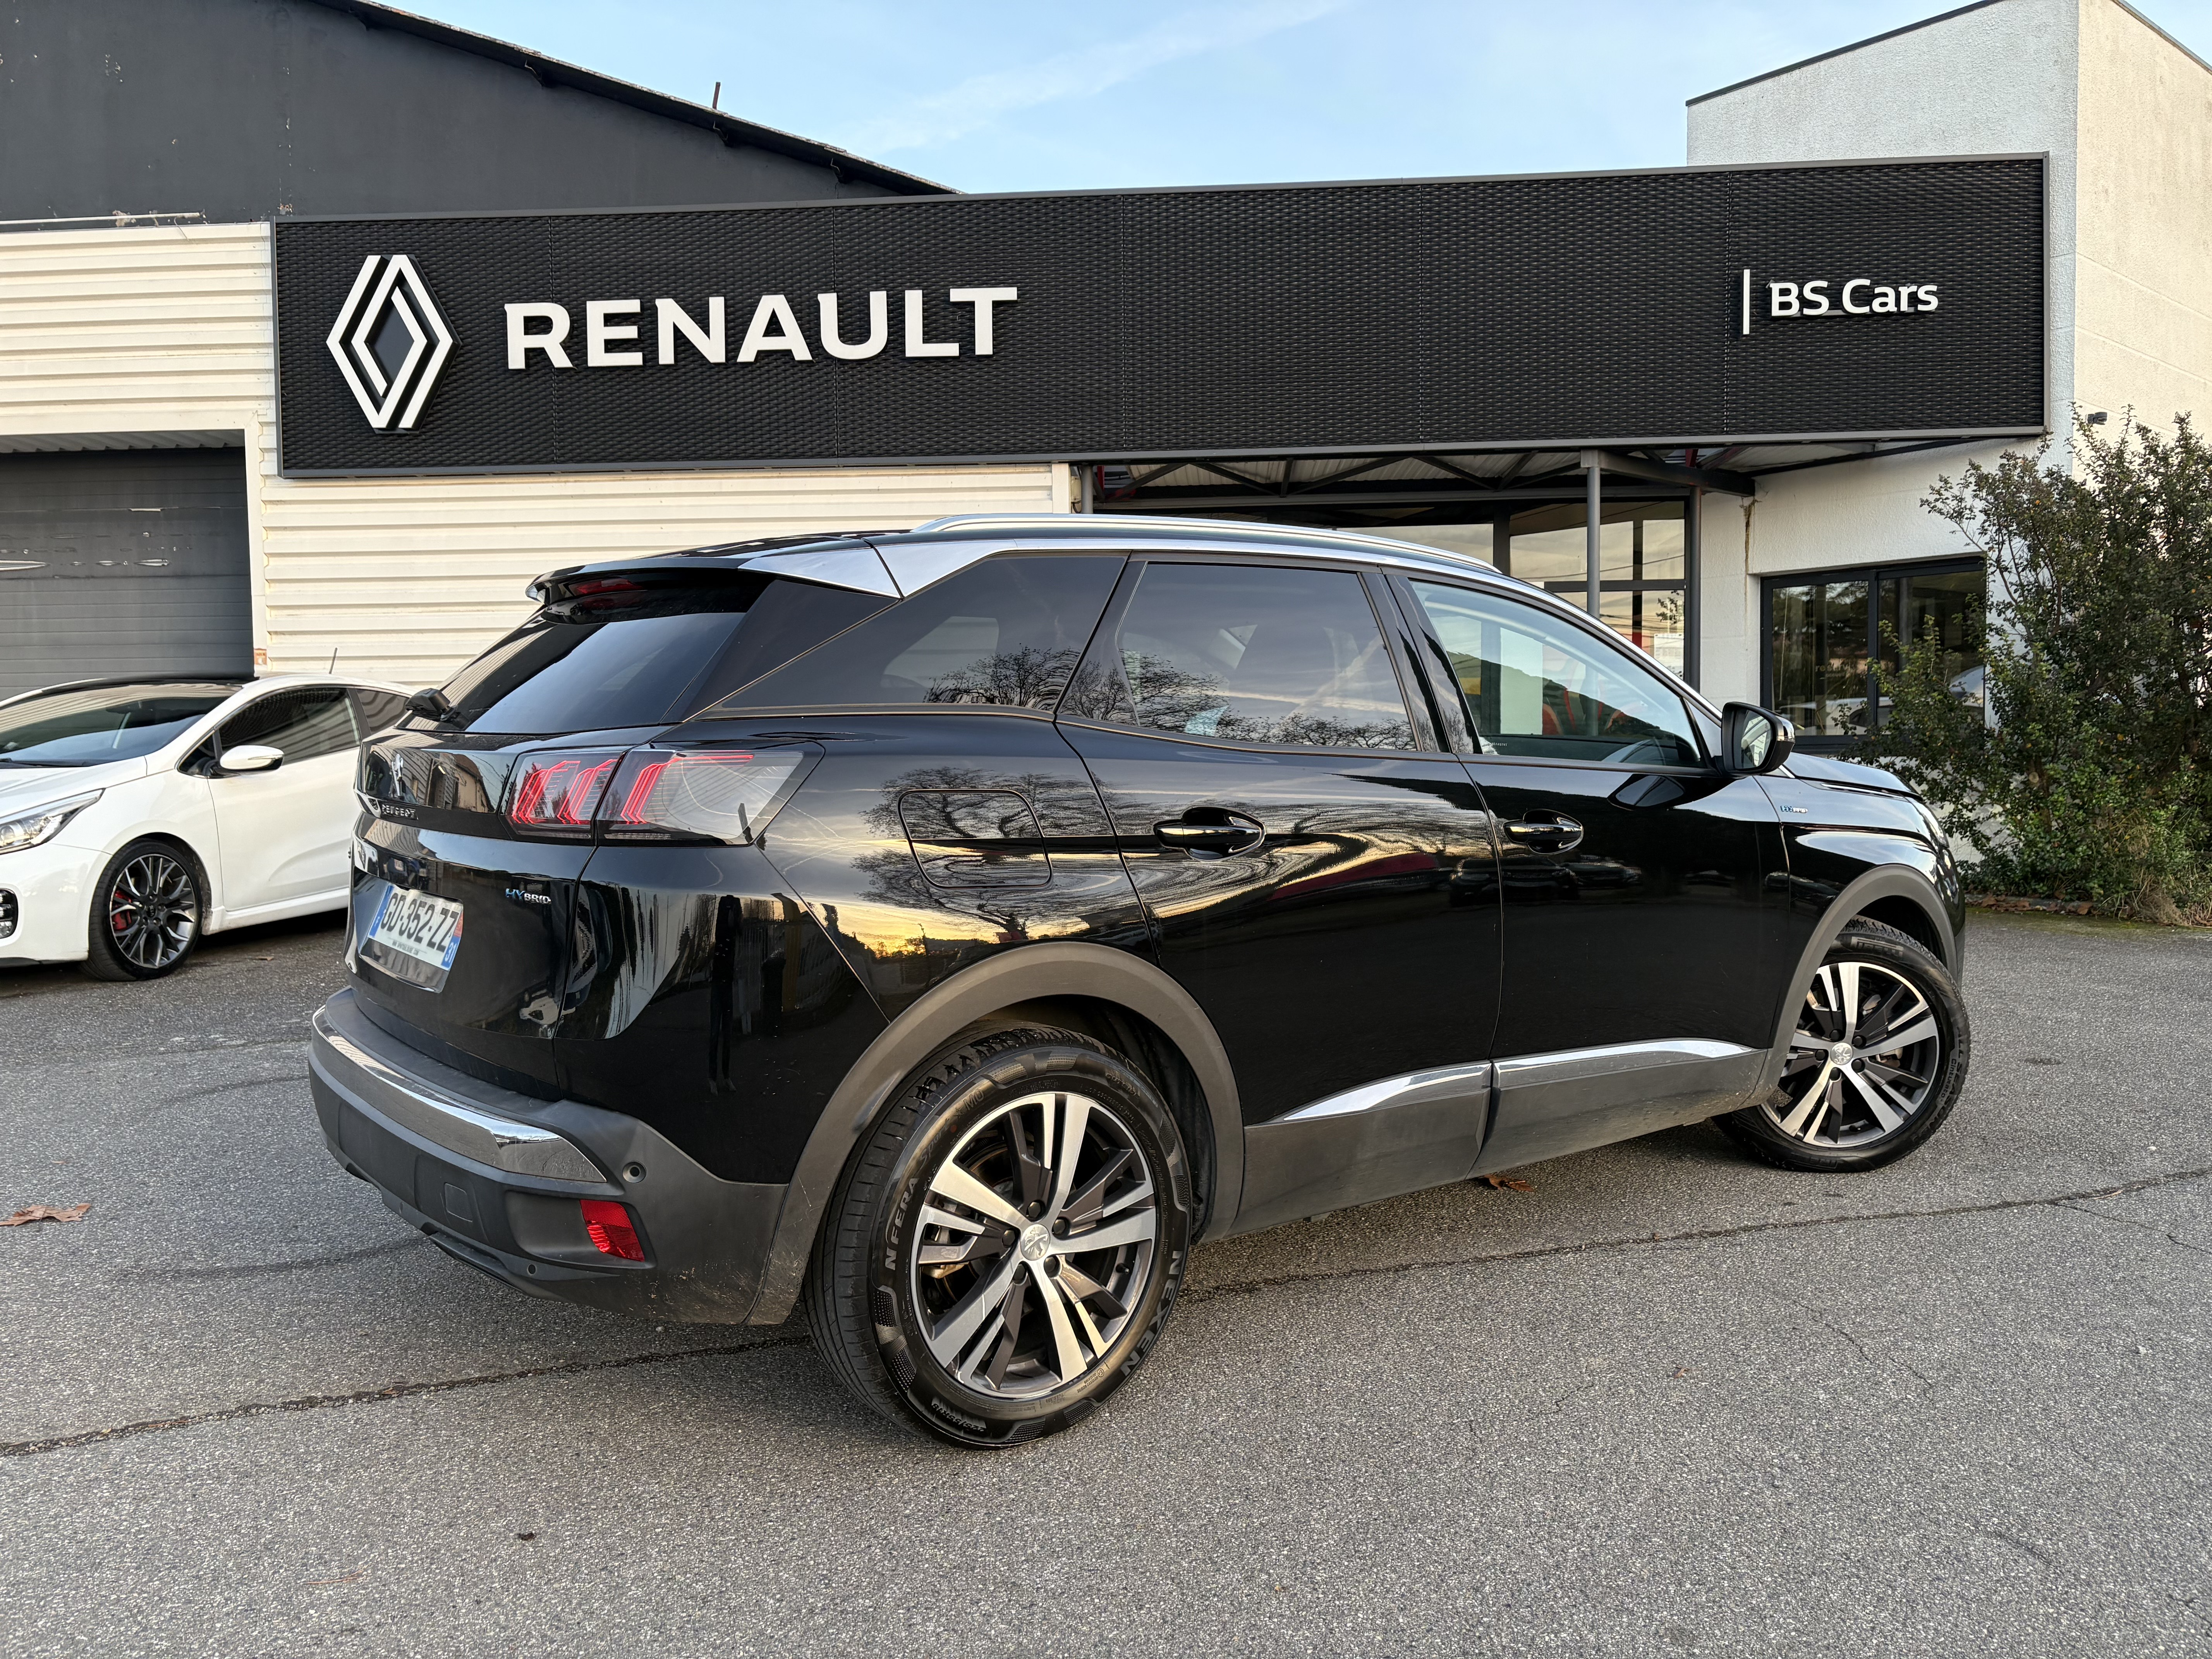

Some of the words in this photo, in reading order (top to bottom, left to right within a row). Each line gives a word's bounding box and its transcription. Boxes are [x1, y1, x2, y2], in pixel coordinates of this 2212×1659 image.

[1769, 280, 1829, 317] BS
[1842, 278, 1939, 314] Cars
[504, 287, 1017, 370] RENAULT
[505, 888, 551, 905] HYBRID
[380, 892, 459, 953] GD-352-ZZ
[445, 942, 457, 963] 31
[1120, 1250, 1183, 1377] NEXEN
